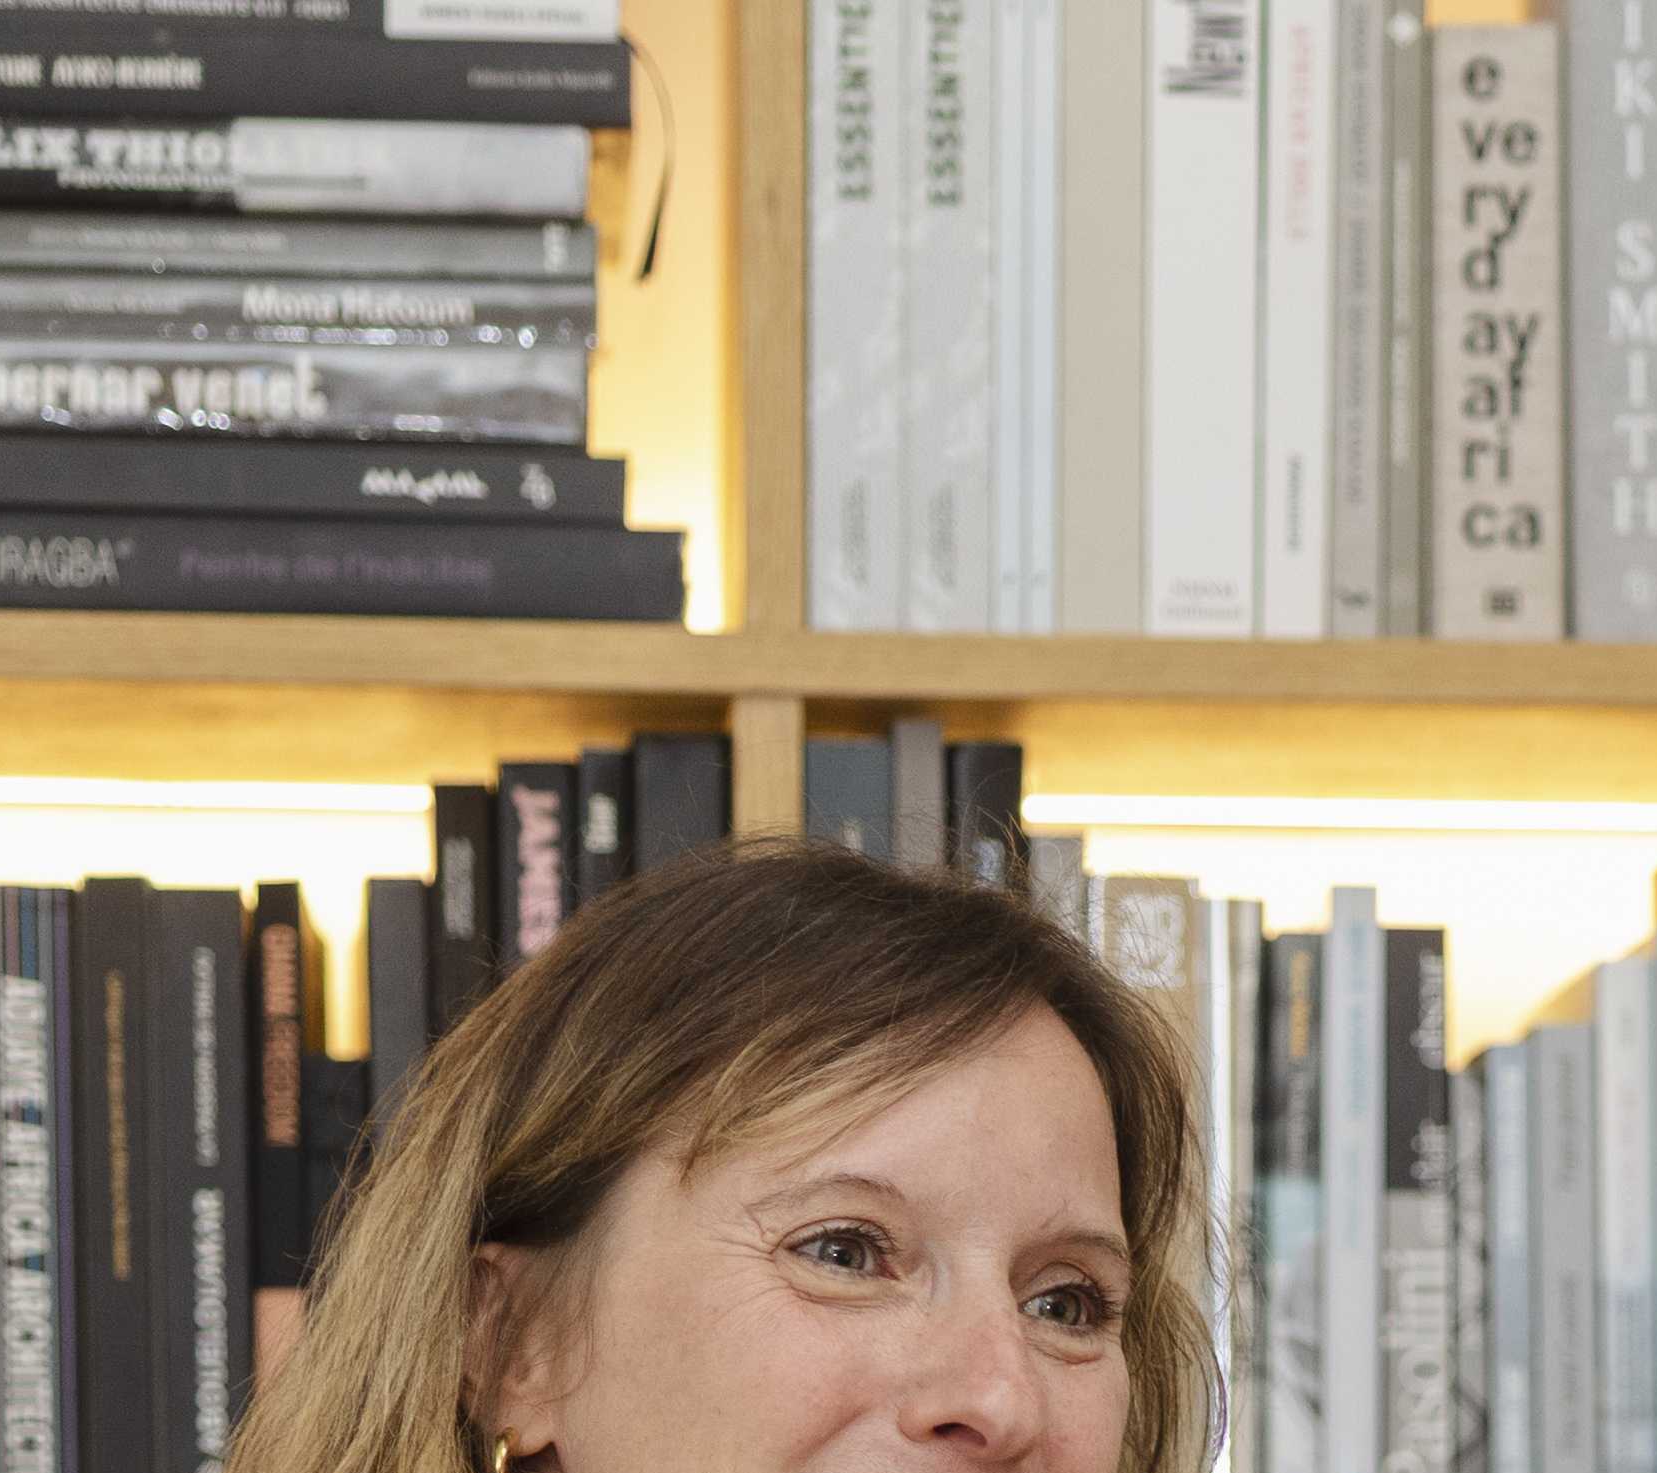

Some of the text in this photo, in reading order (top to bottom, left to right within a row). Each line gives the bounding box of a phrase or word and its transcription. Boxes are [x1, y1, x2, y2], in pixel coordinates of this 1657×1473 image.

[243, 288, 474, 326] Mona Hatoum
[175, 356, 327, 420] venet
[3, 1121, 51, 1256] AFRICA
